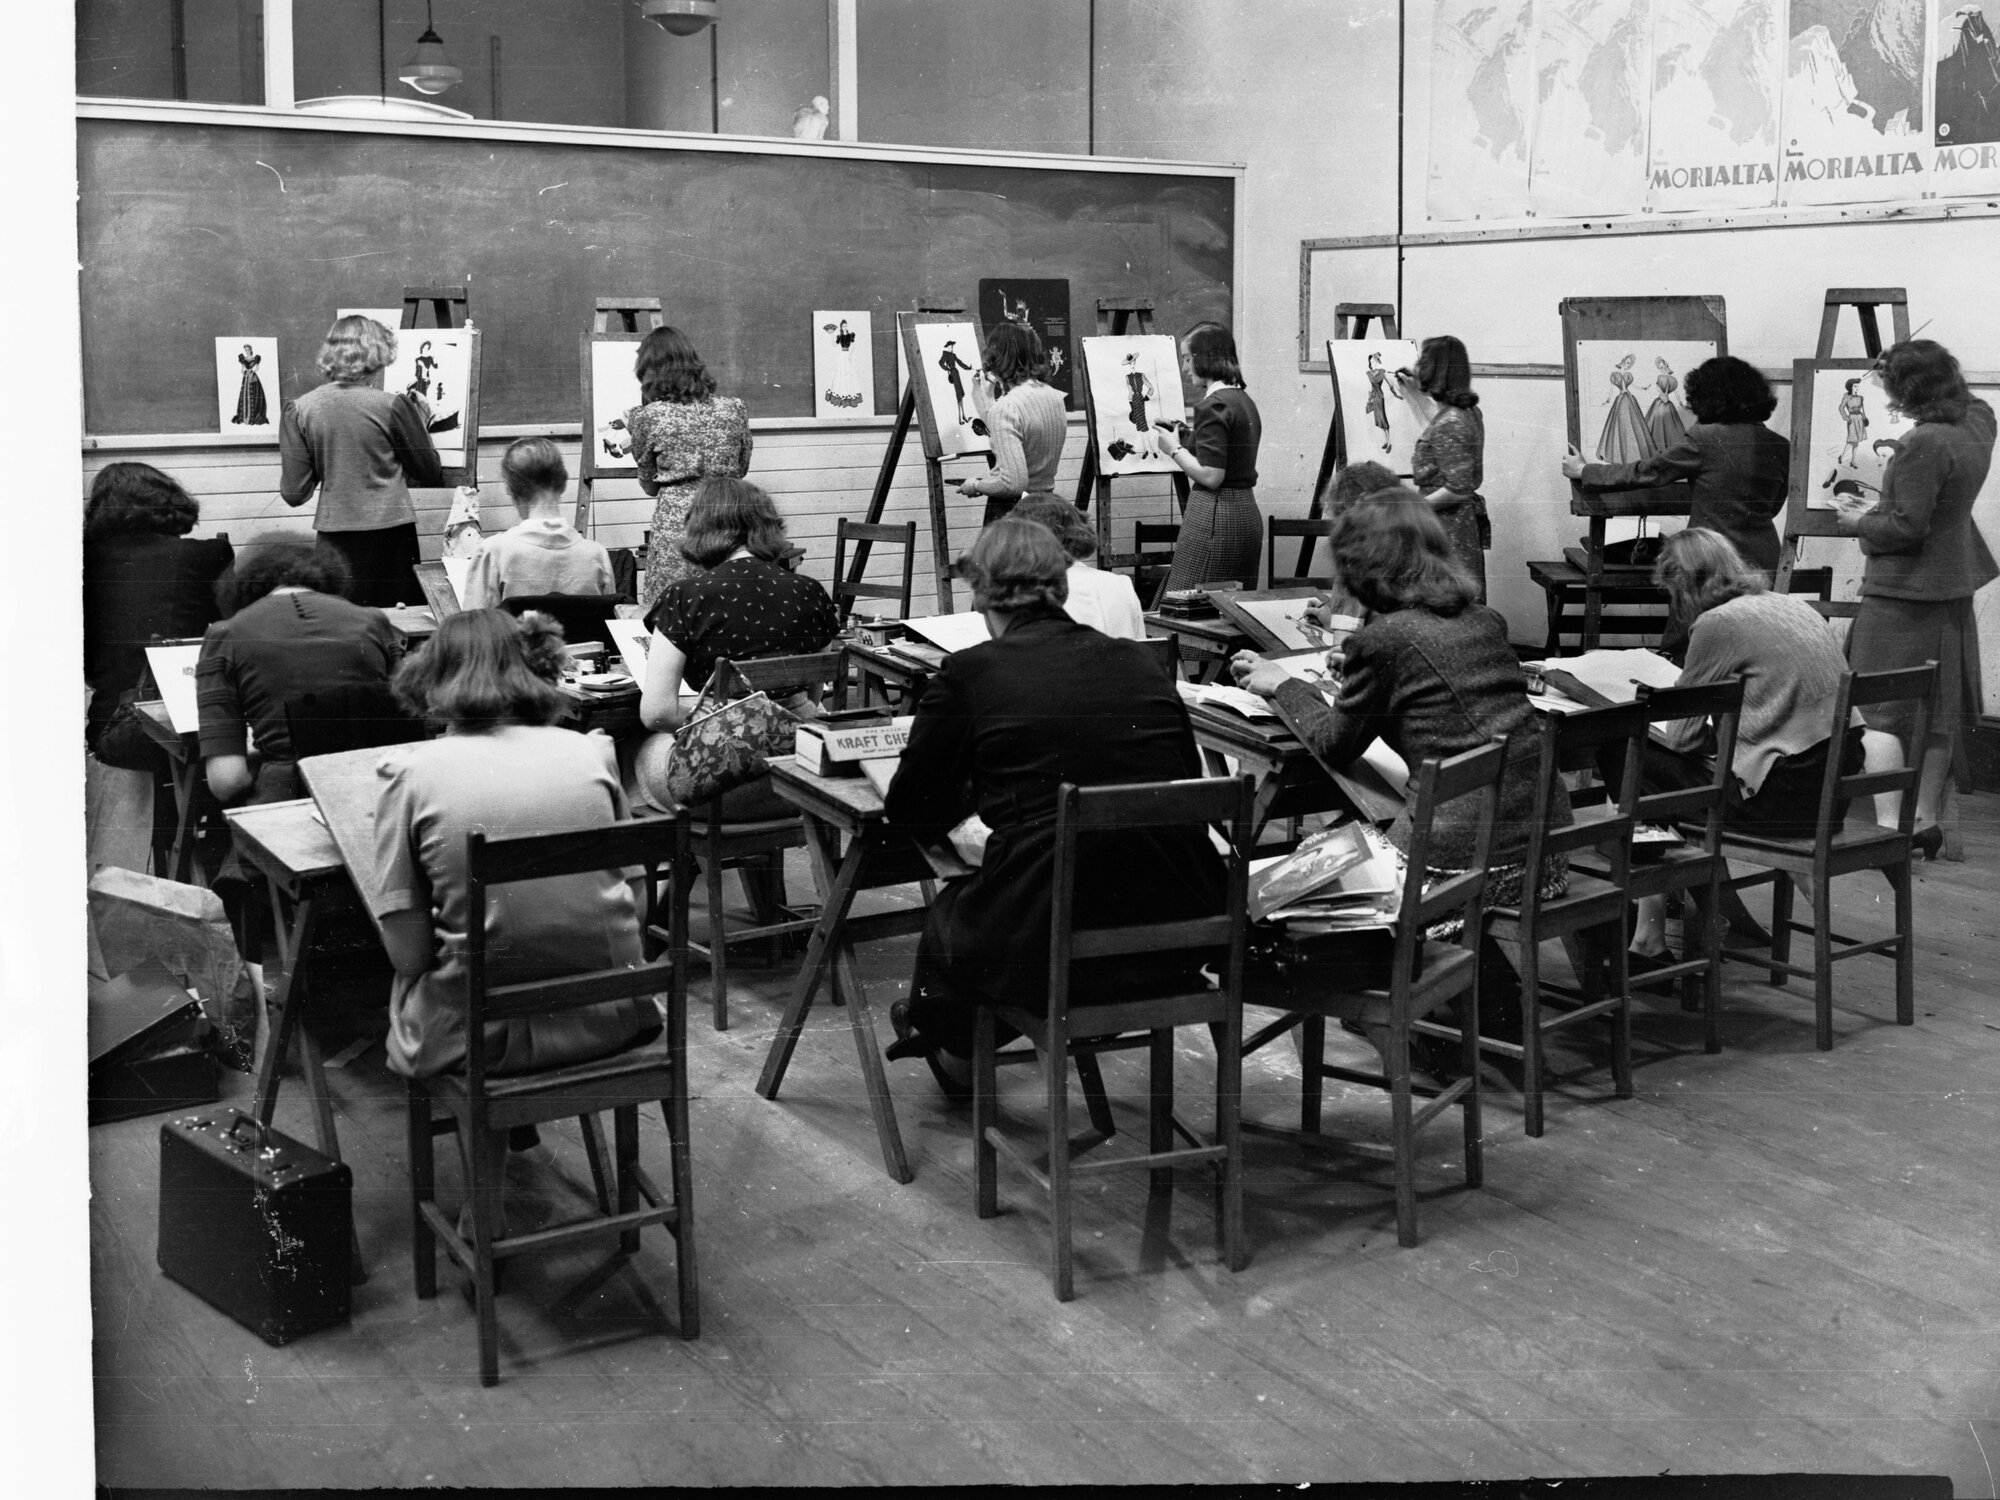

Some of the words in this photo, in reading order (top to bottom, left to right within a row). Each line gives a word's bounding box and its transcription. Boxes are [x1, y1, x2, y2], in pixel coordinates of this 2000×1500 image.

[1784, 151, 1924, 182] MORIALTA
[1934, 145, 2000, 172] MOR
[1649, 163, 1775, 190] MORIALTA
[836, 735, 878, 749] KRAFT
[884, 732, 908, 746] CHE
